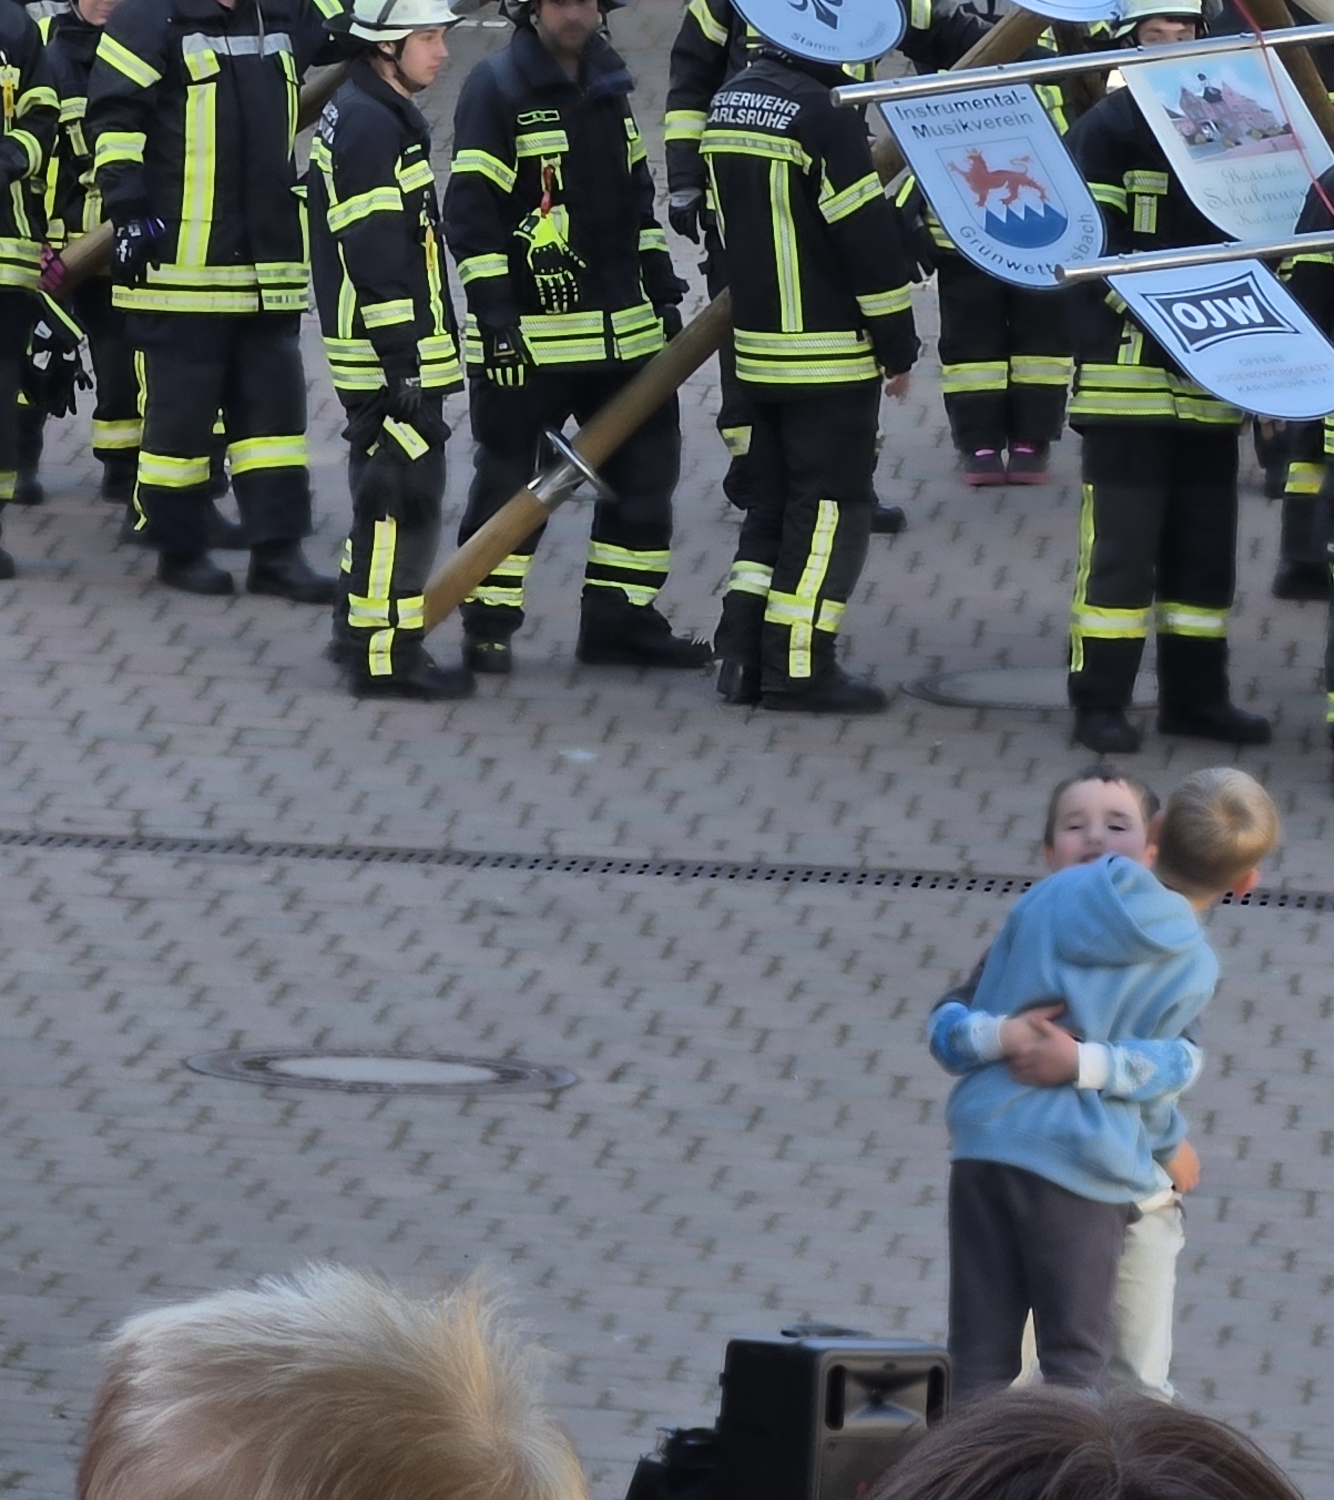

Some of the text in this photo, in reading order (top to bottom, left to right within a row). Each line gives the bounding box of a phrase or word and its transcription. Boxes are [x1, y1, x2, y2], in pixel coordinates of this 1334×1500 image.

[790, 31, 841, 53] Stamm
[894, 89, 1028, 121] Instrumental-
[708, 107, 793, 130] ARLSRUHE
[911, 112, 1035, 140] Musikverein
[958, 212, 1096, 276] Grünwettsbach
[1171, 294, 1265, 331] OJW
[1238, 354, 1287, 367] OFFENE
[1235, 378, 1309, 394] KARLSRUHE
